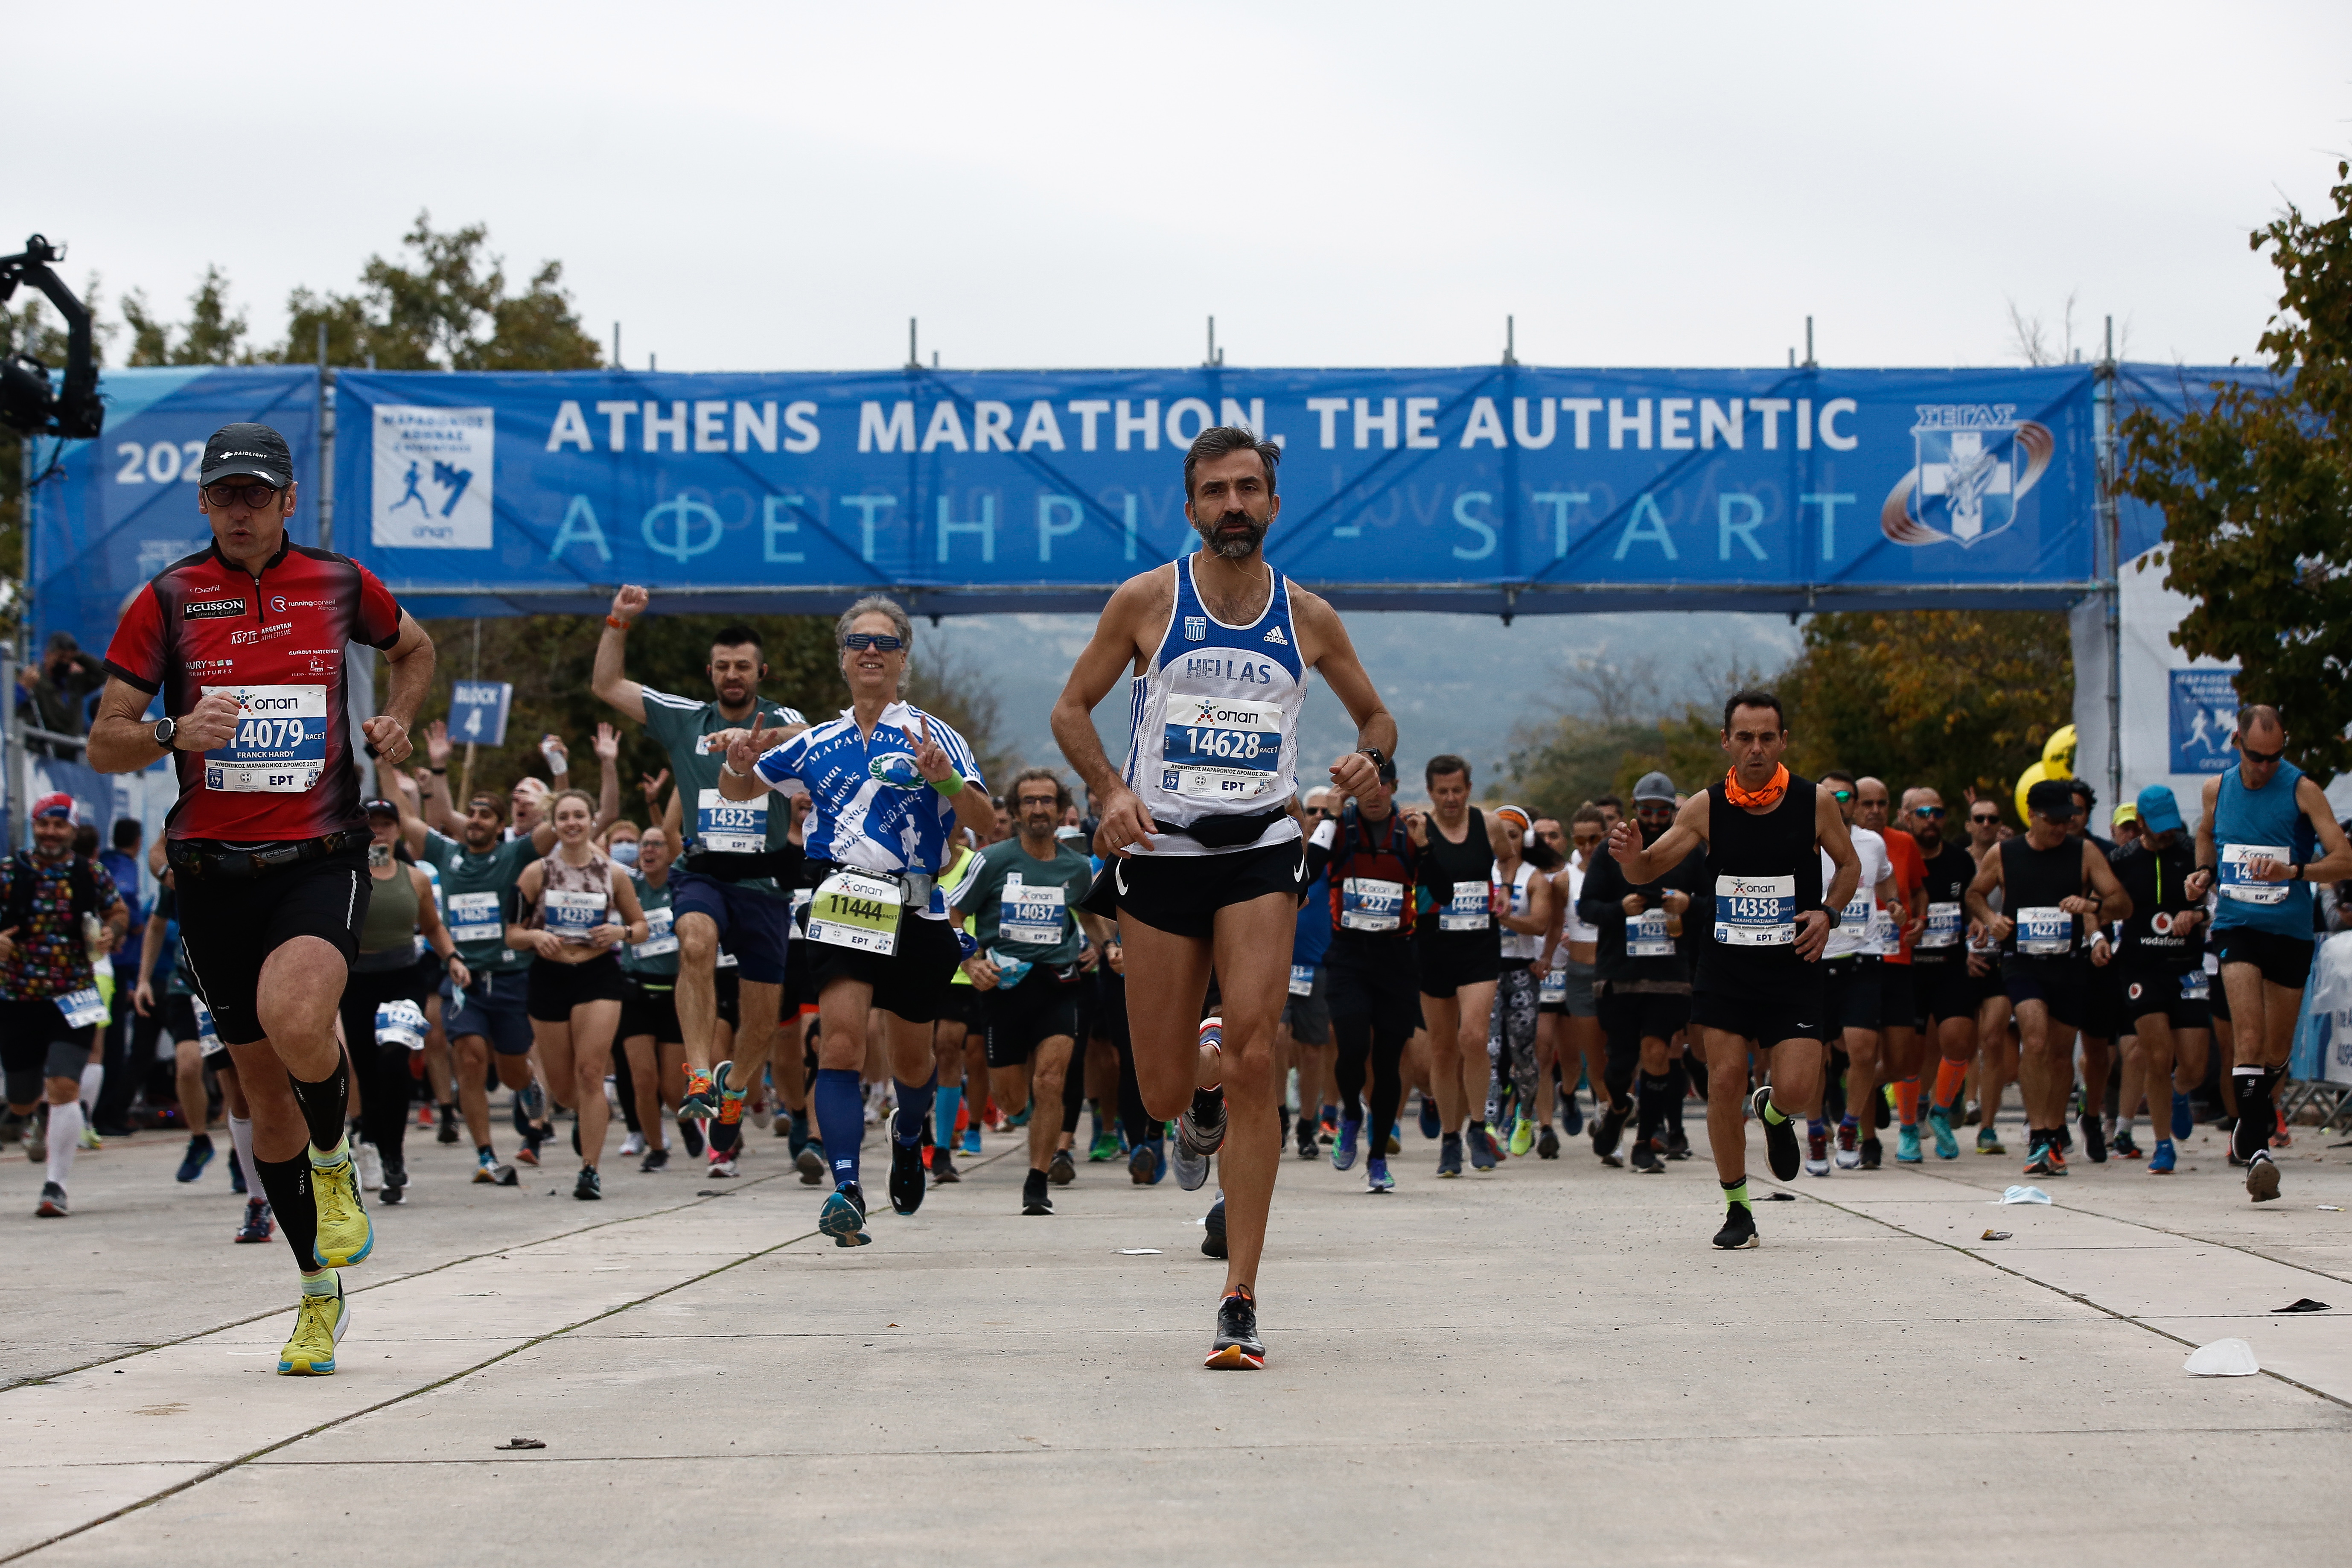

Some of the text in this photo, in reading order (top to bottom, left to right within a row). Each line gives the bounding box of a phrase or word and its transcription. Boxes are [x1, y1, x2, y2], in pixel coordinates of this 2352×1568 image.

[545, 400, 821, 452] ATHENS
[1306, 397, 1440, 450] THE
[1459, 396, 1859, 451] AUTHENTIC
[1915, 403, 2017, 427] ΣΕΓΑΣ
[116, 440, 206, 484] 202
[234, 451, 268, 459] RAIDLIGHT
[1451, 490, 1856, 561] START
[194, 585, 221, 594] Defil
[186, 600, 244, 613] ÉCUSSON
[231, 630, 259, 645] ASPTT
[261, 622, 292, 635] ARGENTAN
[261, 629, 291, 641] ATHLÉTISME
[1263, 635, 1288, 645] adidas
[186, 660, 207, 670] AURY
[1186, 658, 1271, 685] HELLAS
[230, 719, 304, 749] 14079
[808, 730, 913, 765] ΜΑΡΑΘΩΝΙΟ
[1186, 728, 1261, 759] 14628
[709, 809, 755, 827] 14325
[830, 894, 883, 922] 11444
[1013, 903, 1055, 921] 14037
[1359, 895, 1392, 911] 4227
[1728, 898, 1780, 917] 14358
[556, 906, 595, 924] 14239
[1637, 922, 1665, 936] 1423
[2140, 936, 2186, 947] vodafone
